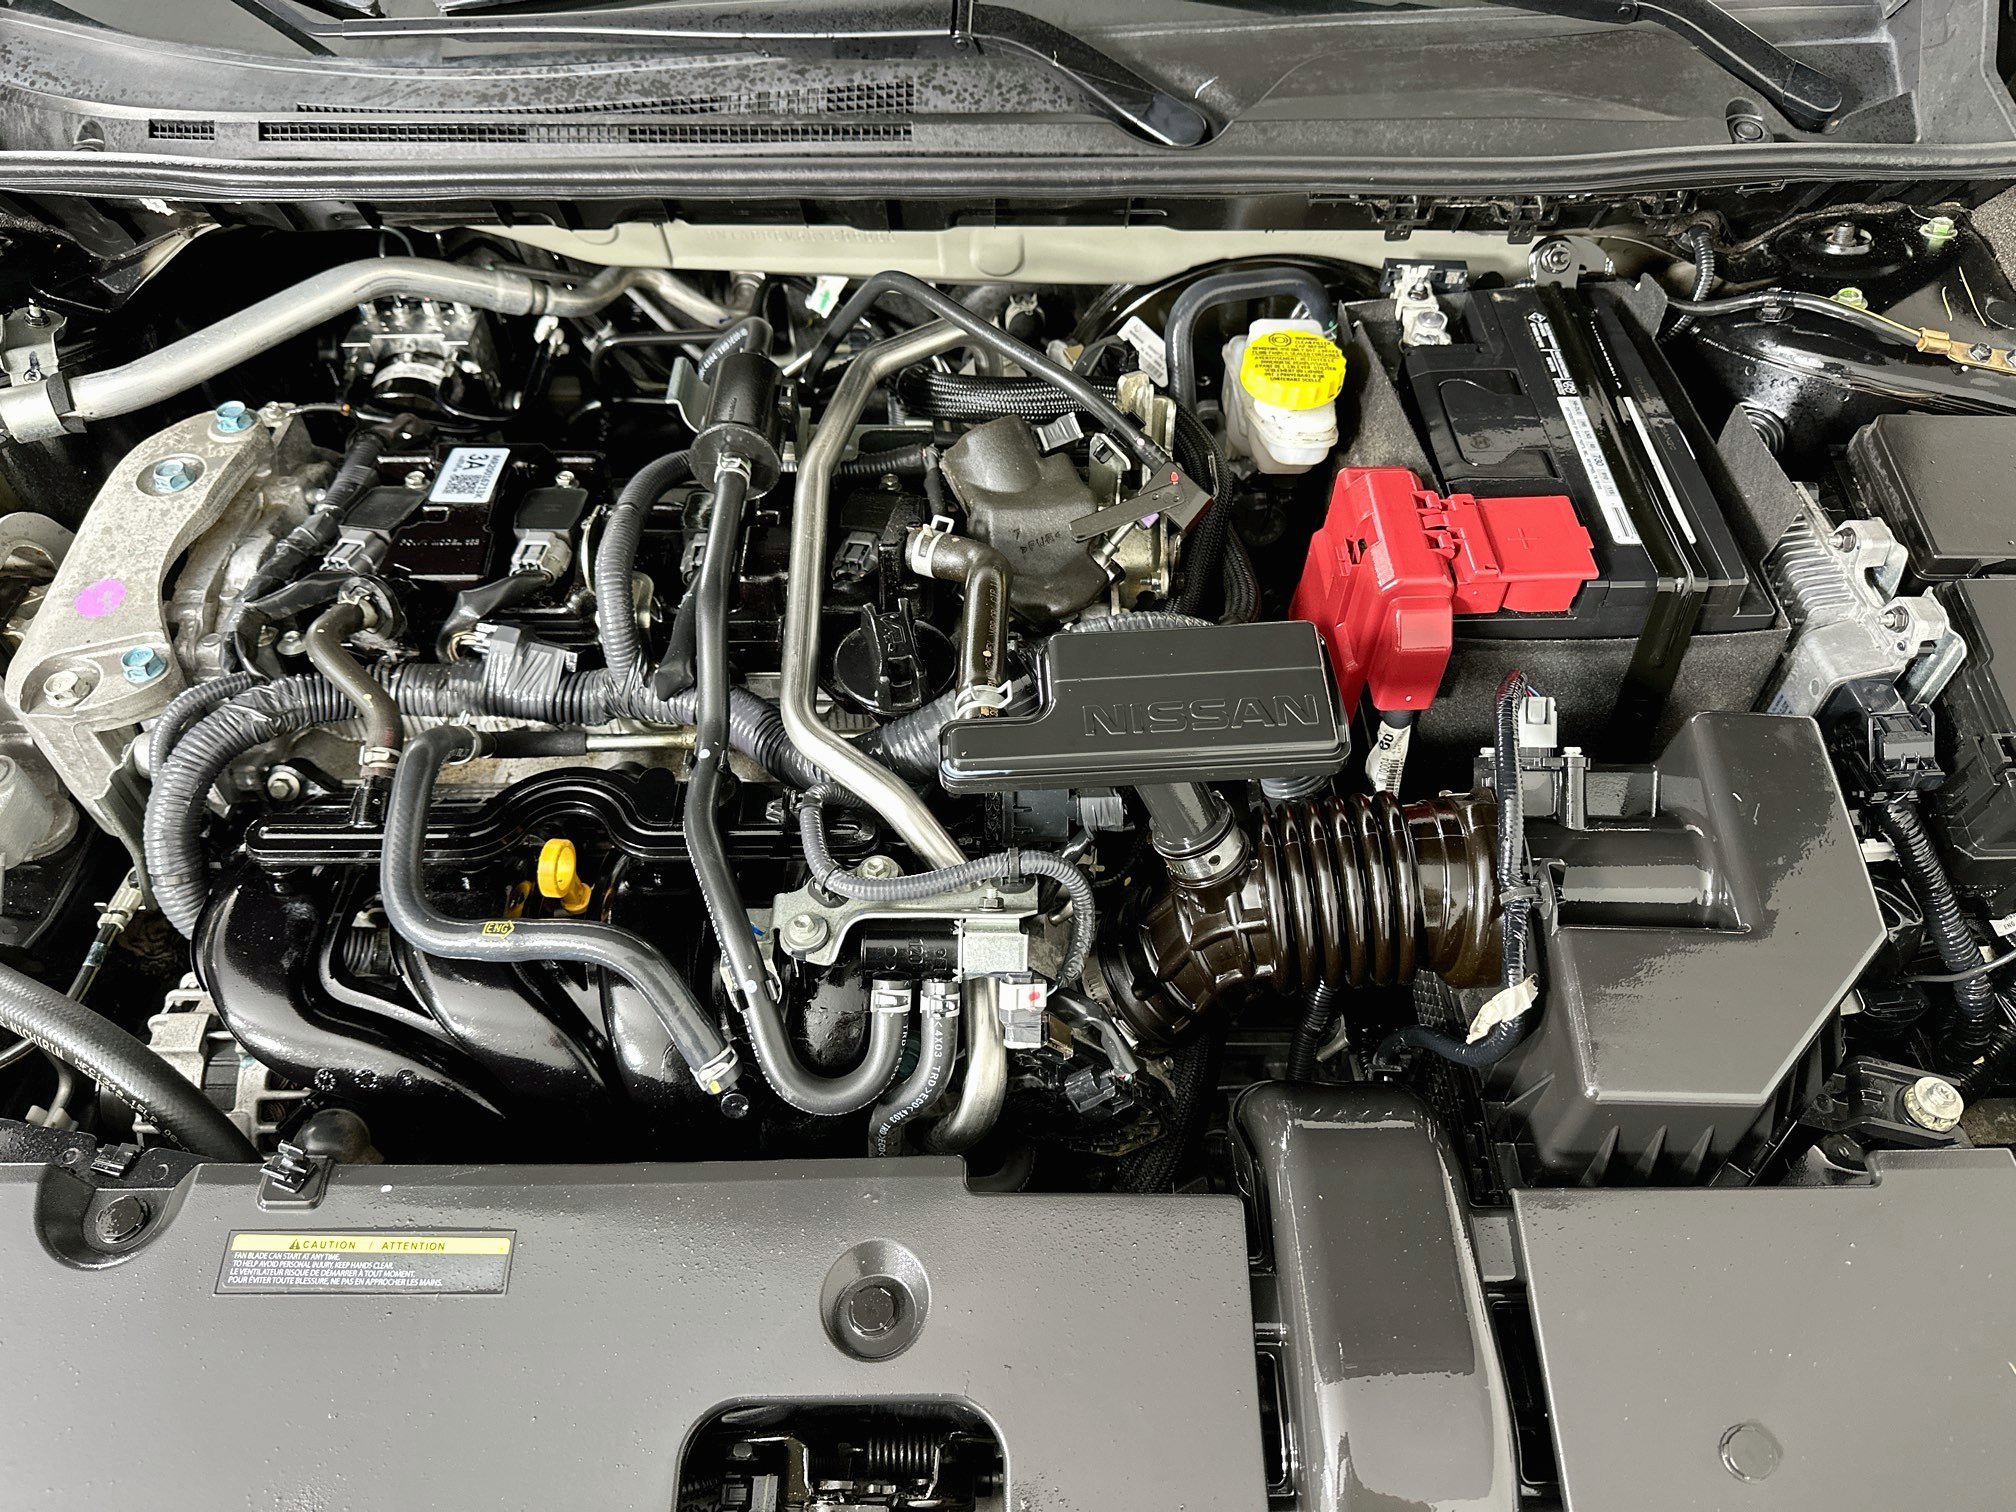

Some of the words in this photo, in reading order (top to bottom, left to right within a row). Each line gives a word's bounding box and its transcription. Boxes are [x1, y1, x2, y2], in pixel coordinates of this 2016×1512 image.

[464, 454, 490, 470] 3A
[1082, 693, 1321, 737] NISSAN
[486, 923, 510, 933] ENG
[302, 1240, 356, 1250] CAUTION
[382, 1241, 446, 1251] ATTENTION
[248, 1252, 268, 1260] BLADE
[268, 1252, 282, 1260] CAN
[311, 1261, 334, 1269] INJURY,
[239, 1268, 284, 1276] VENTILATEUR
[284, 1268, 309, 1276] RISQUE
[320, 1268, 357, 1277] DÉMARRER
[383, 1270, 416, 1278] MOMENT.
[228, 1276, 248, 1284] POUR
[248, 1276, 272, 1284] ÉVITER
[295, 1277, 330, 1285] BLESSURE,
[365, 1278, 407, 1286] APPROCHER
